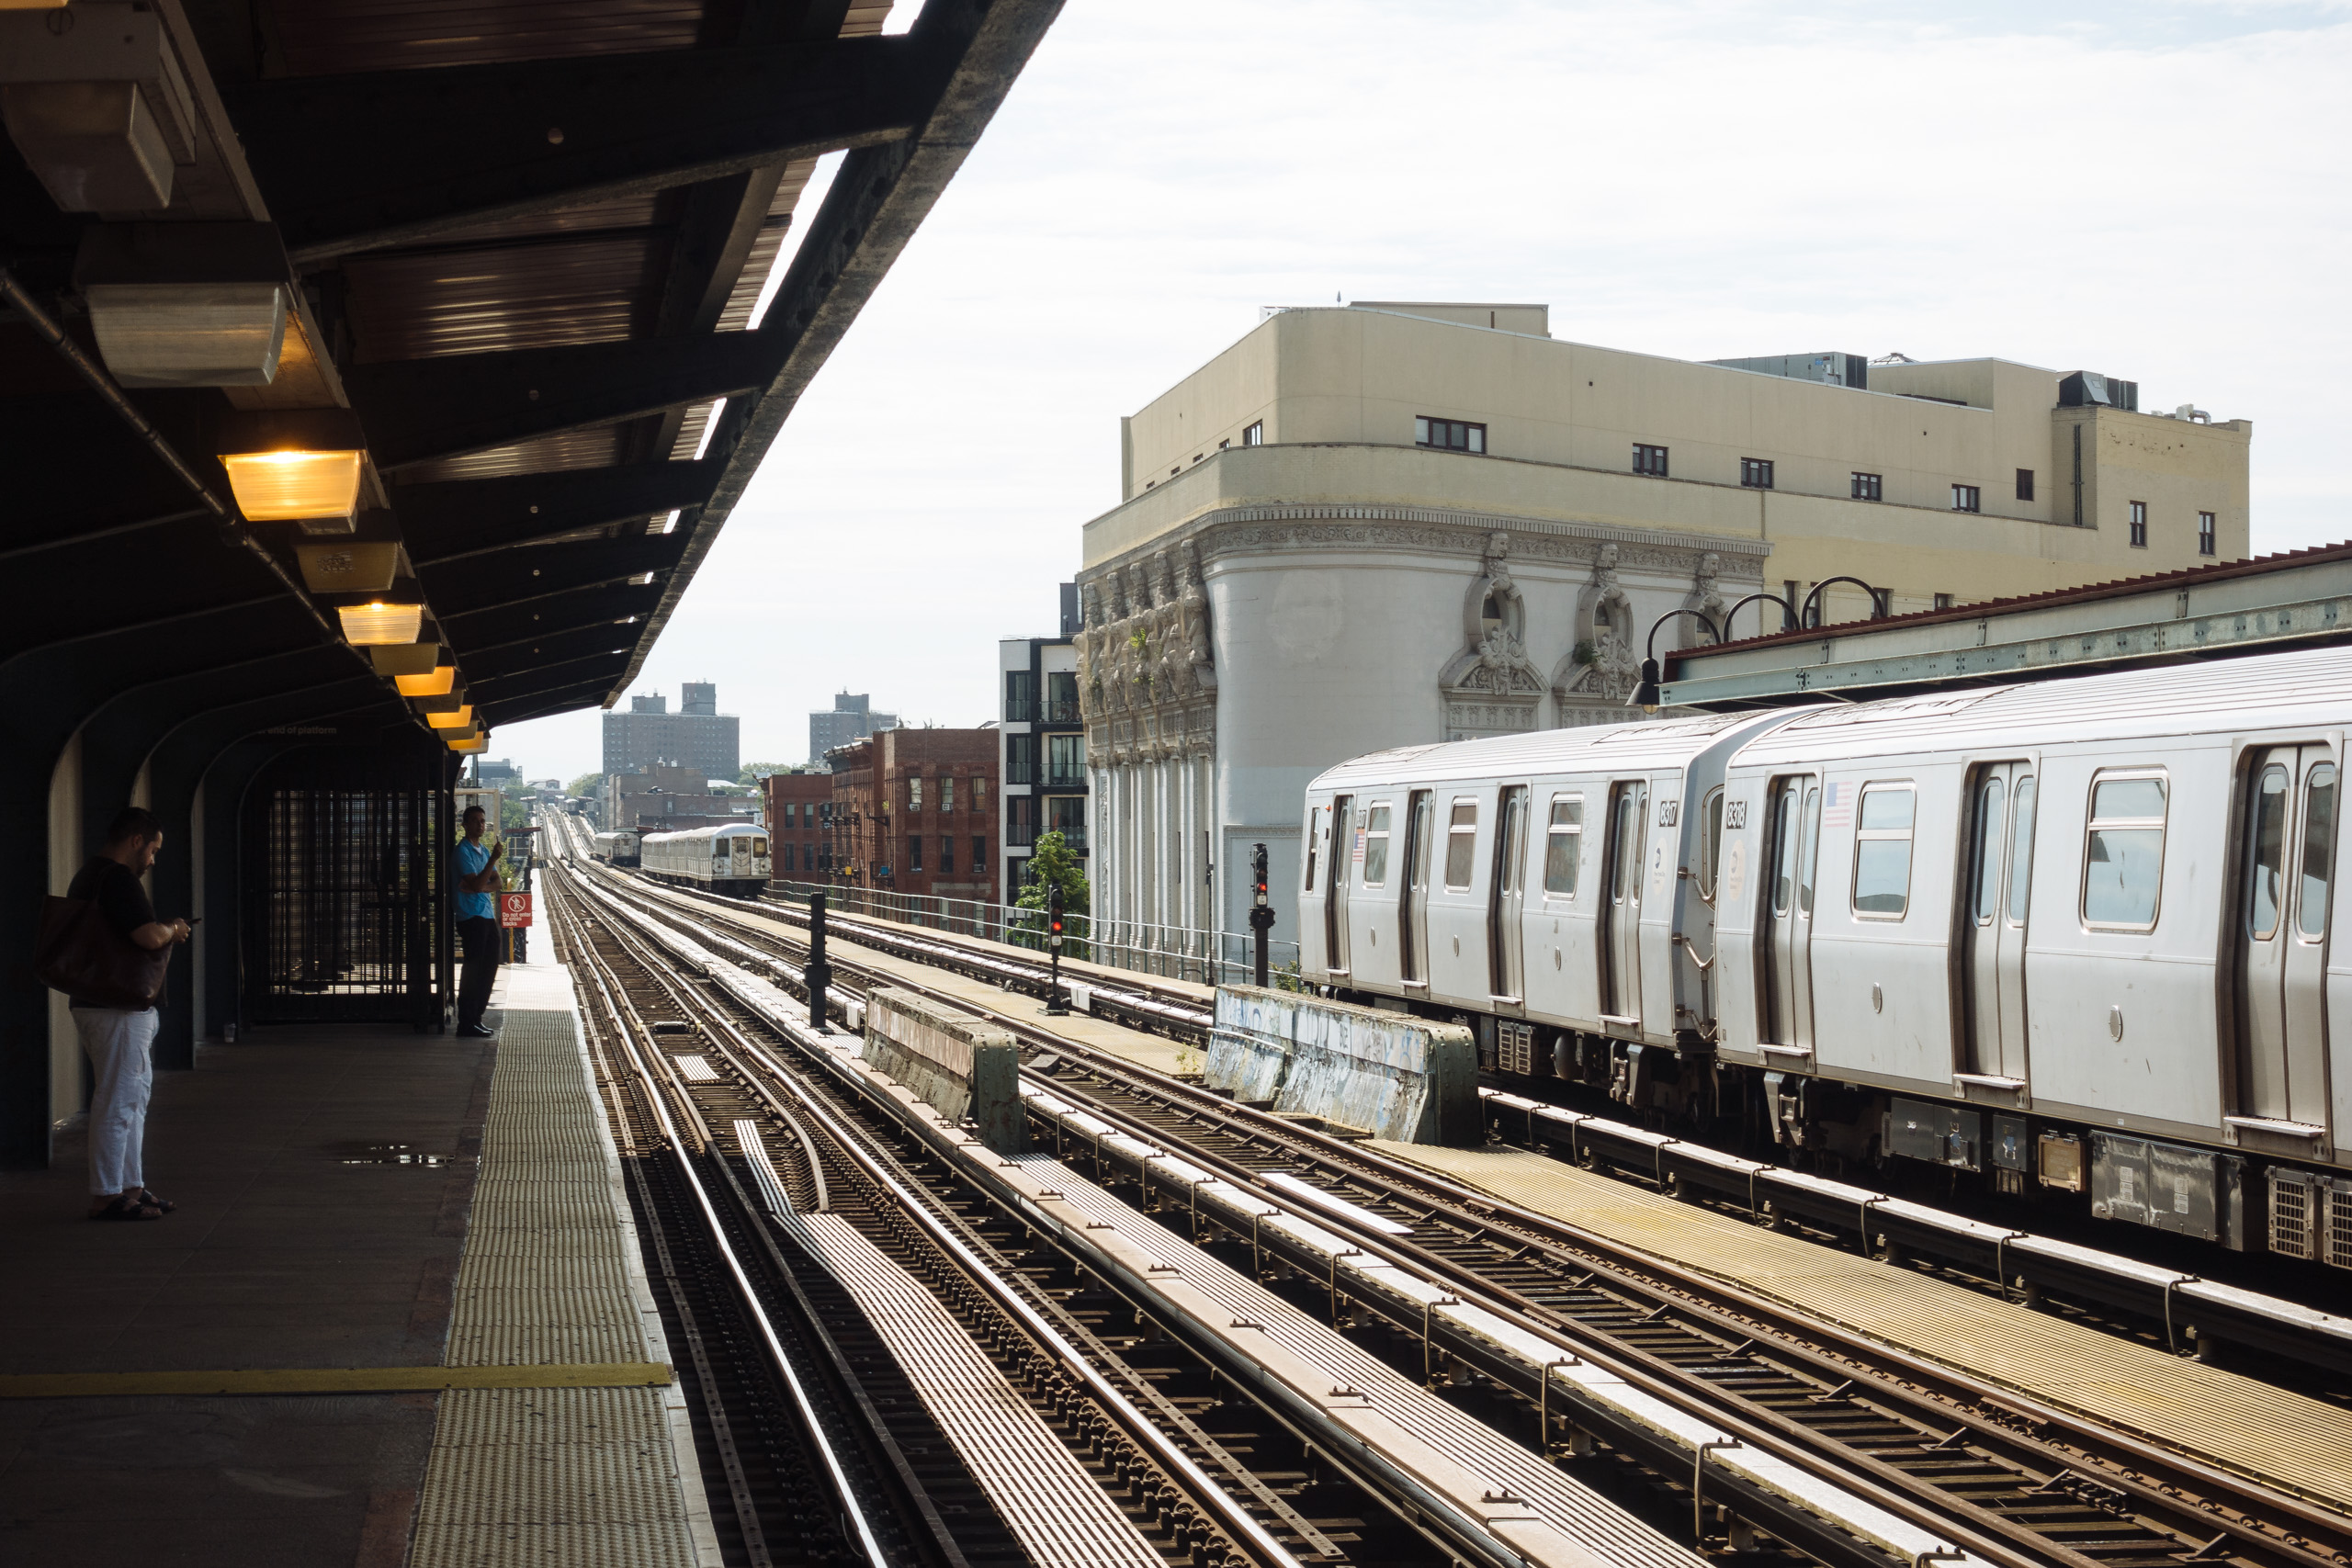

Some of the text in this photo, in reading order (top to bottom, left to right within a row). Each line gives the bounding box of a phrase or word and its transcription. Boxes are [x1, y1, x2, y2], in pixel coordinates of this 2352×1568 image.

[267, 726, 286, 734] end
[287, 726, 297, 734] of
[298, 726, 337, 736] platform
[1660, 802, 1677, 825] 8317
[1727, 803, 1746, 826] 8318
